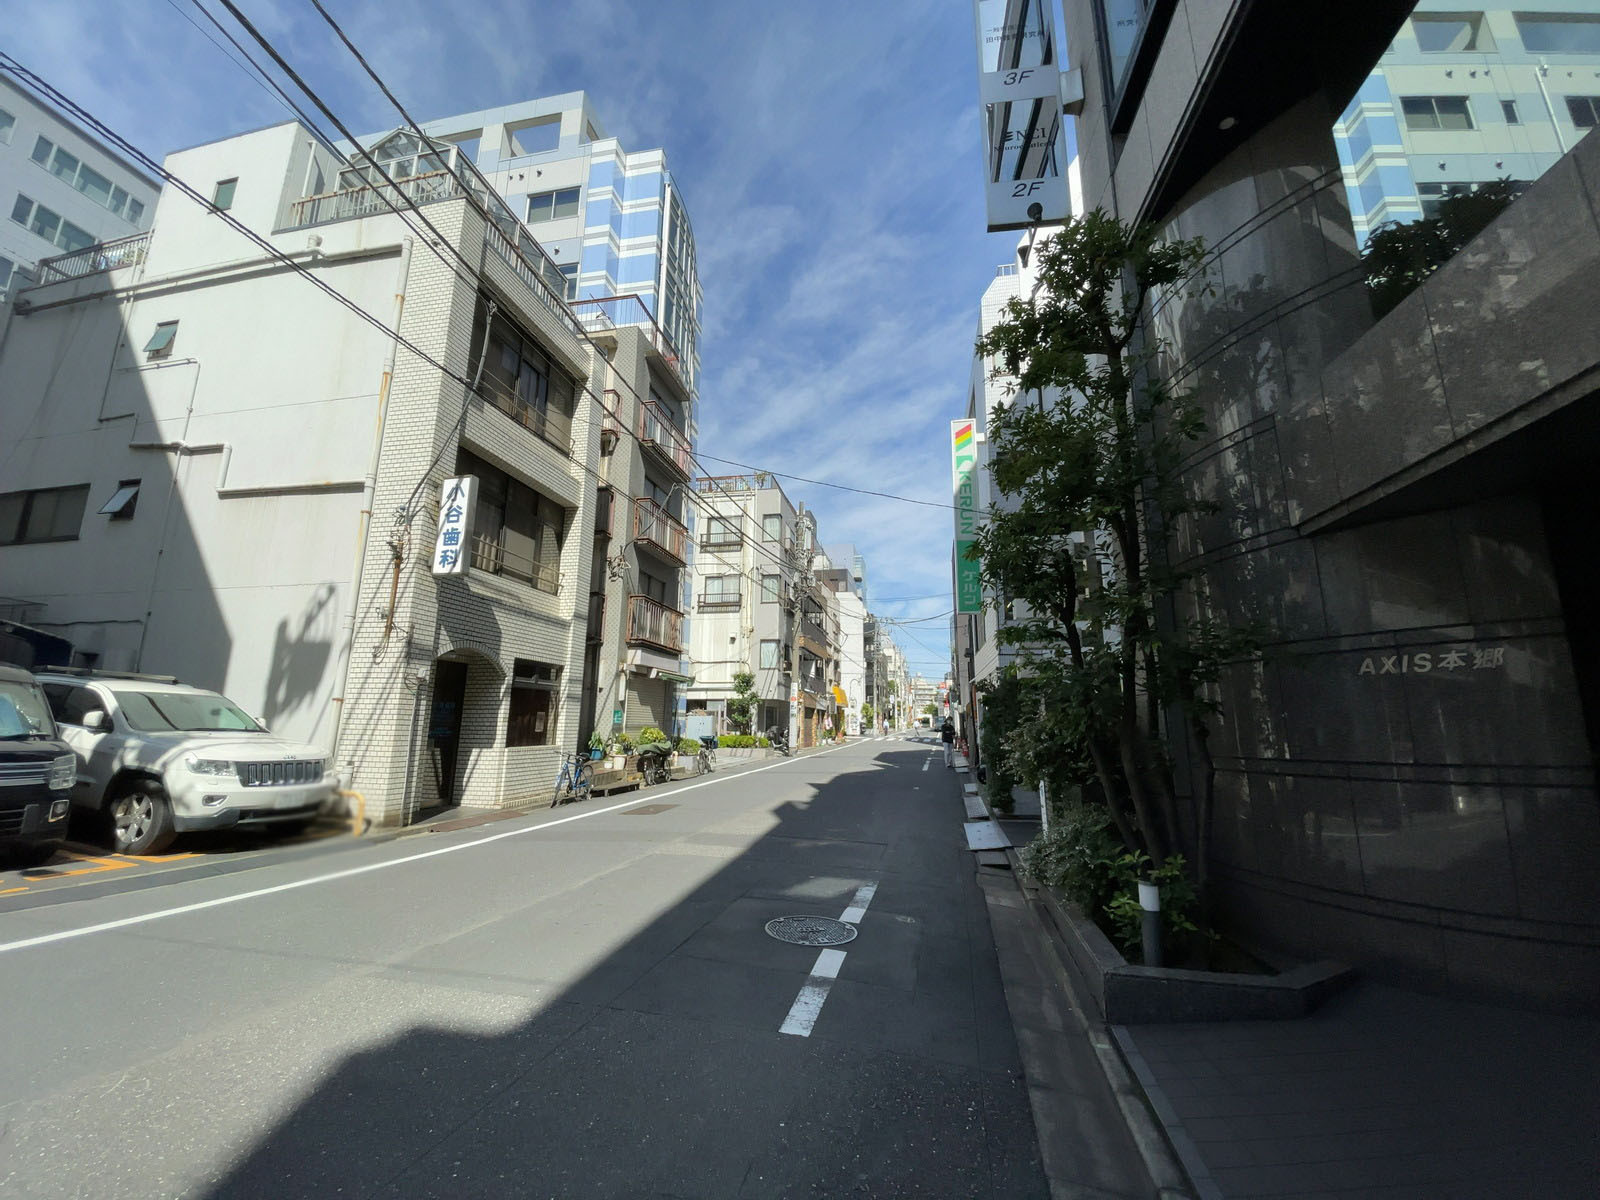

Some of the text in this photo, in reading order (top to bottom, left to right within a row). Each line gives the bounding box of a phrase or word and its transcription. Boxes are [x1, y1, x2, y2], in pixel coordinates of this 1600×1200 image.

[1003, 69, 1034, 86] 3F
[1011, 181, 1044, 198] 2F
[438, 483, 465, 569] 小谷歯科
